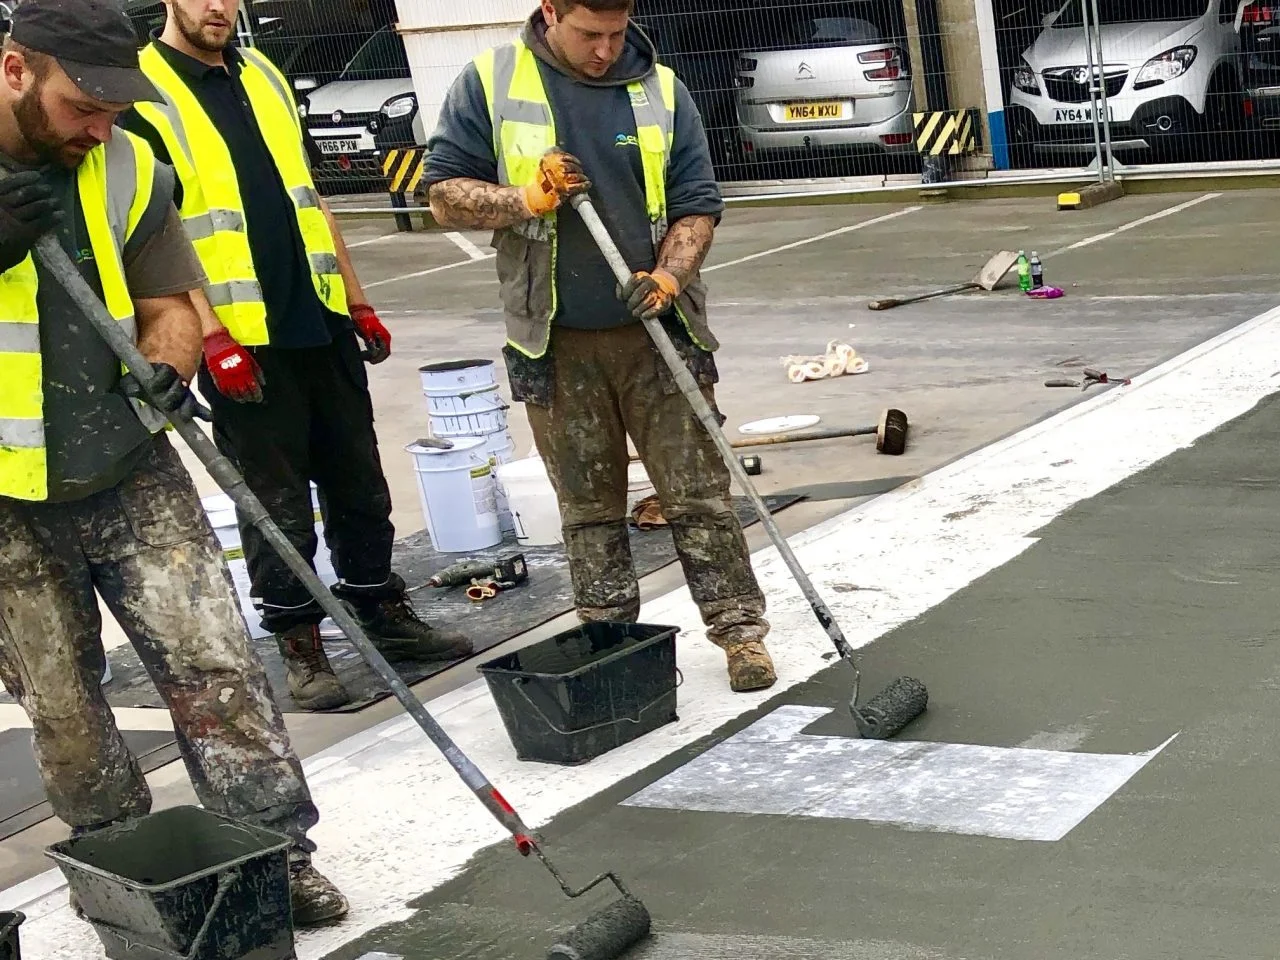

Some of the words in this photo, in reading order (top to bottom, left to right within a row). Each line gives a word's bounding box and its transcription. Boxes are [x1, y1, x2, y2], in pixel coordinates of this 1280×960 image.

[790, 106, 815, 118] YN64
[818, 105, 838, 117] WXU
[1055, 109, 1083, 122] AY64
